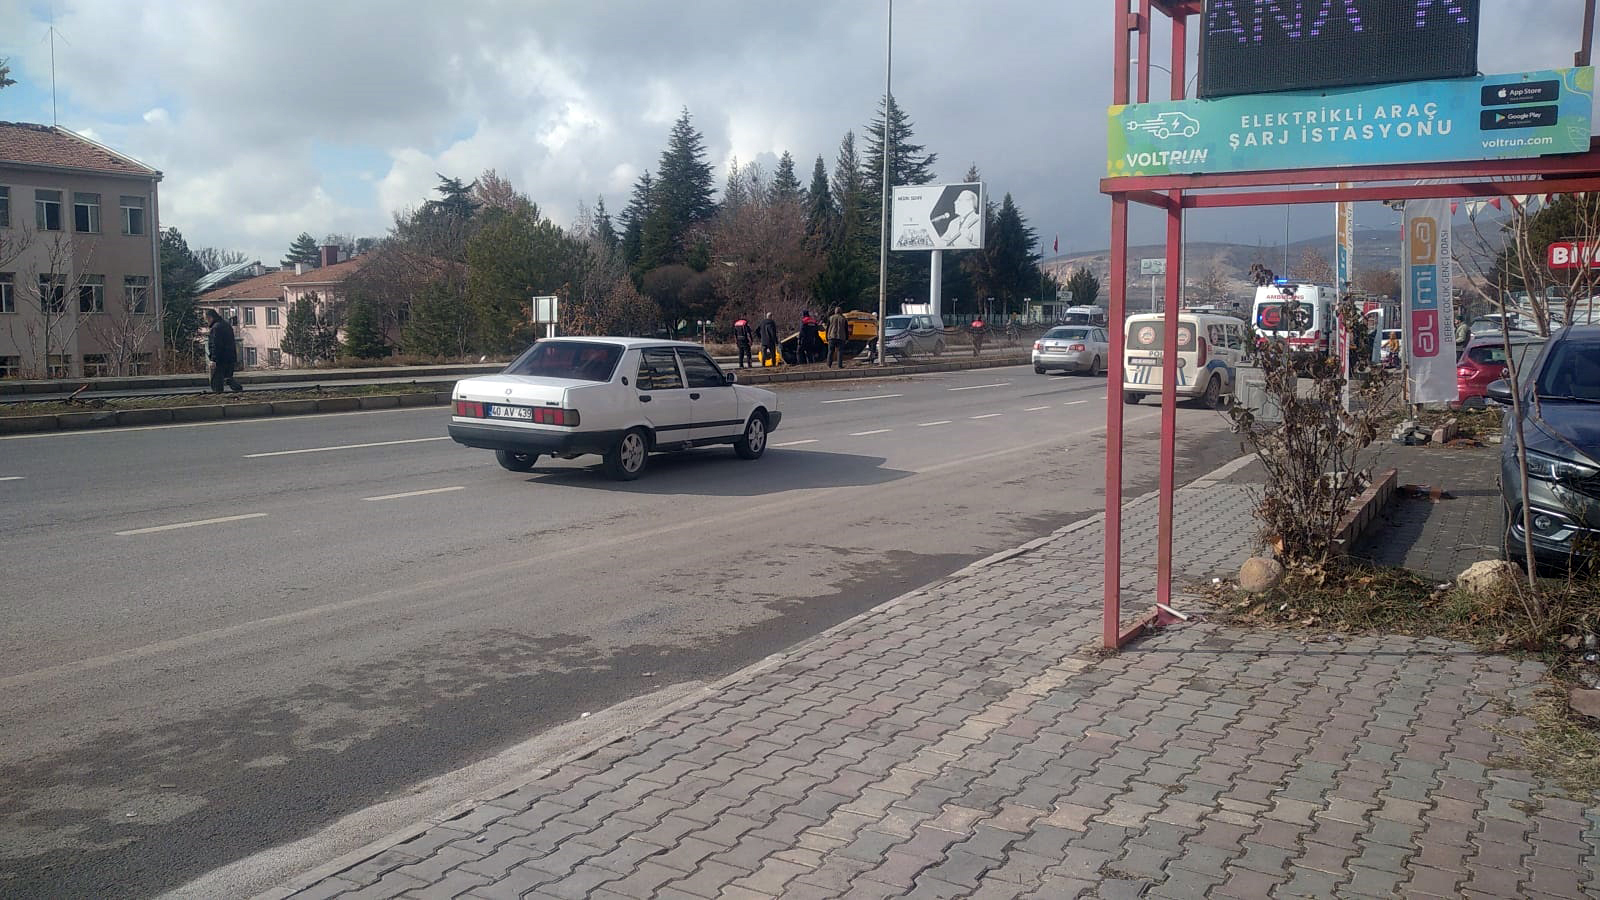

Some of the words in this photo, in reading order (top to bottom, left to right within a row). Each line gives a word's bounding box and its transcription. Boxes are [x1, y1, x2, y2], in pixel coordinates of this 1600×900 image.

[1241, 104, 1362, 128] ELEKTRİKLİ
[1374, 102, 1439, 120] ARAÇ
[1229, 129, 1289, 151] ŞARJ
[1301, 119, 1452, 144] İSTASYONU
[1482, 136, 1553, 148] voltrun.com
[1126, 149, 1208, 168] VOLTRUN
[1440, 230, 1449, 255] ODASI
[503, 408, 515, 417] AV
